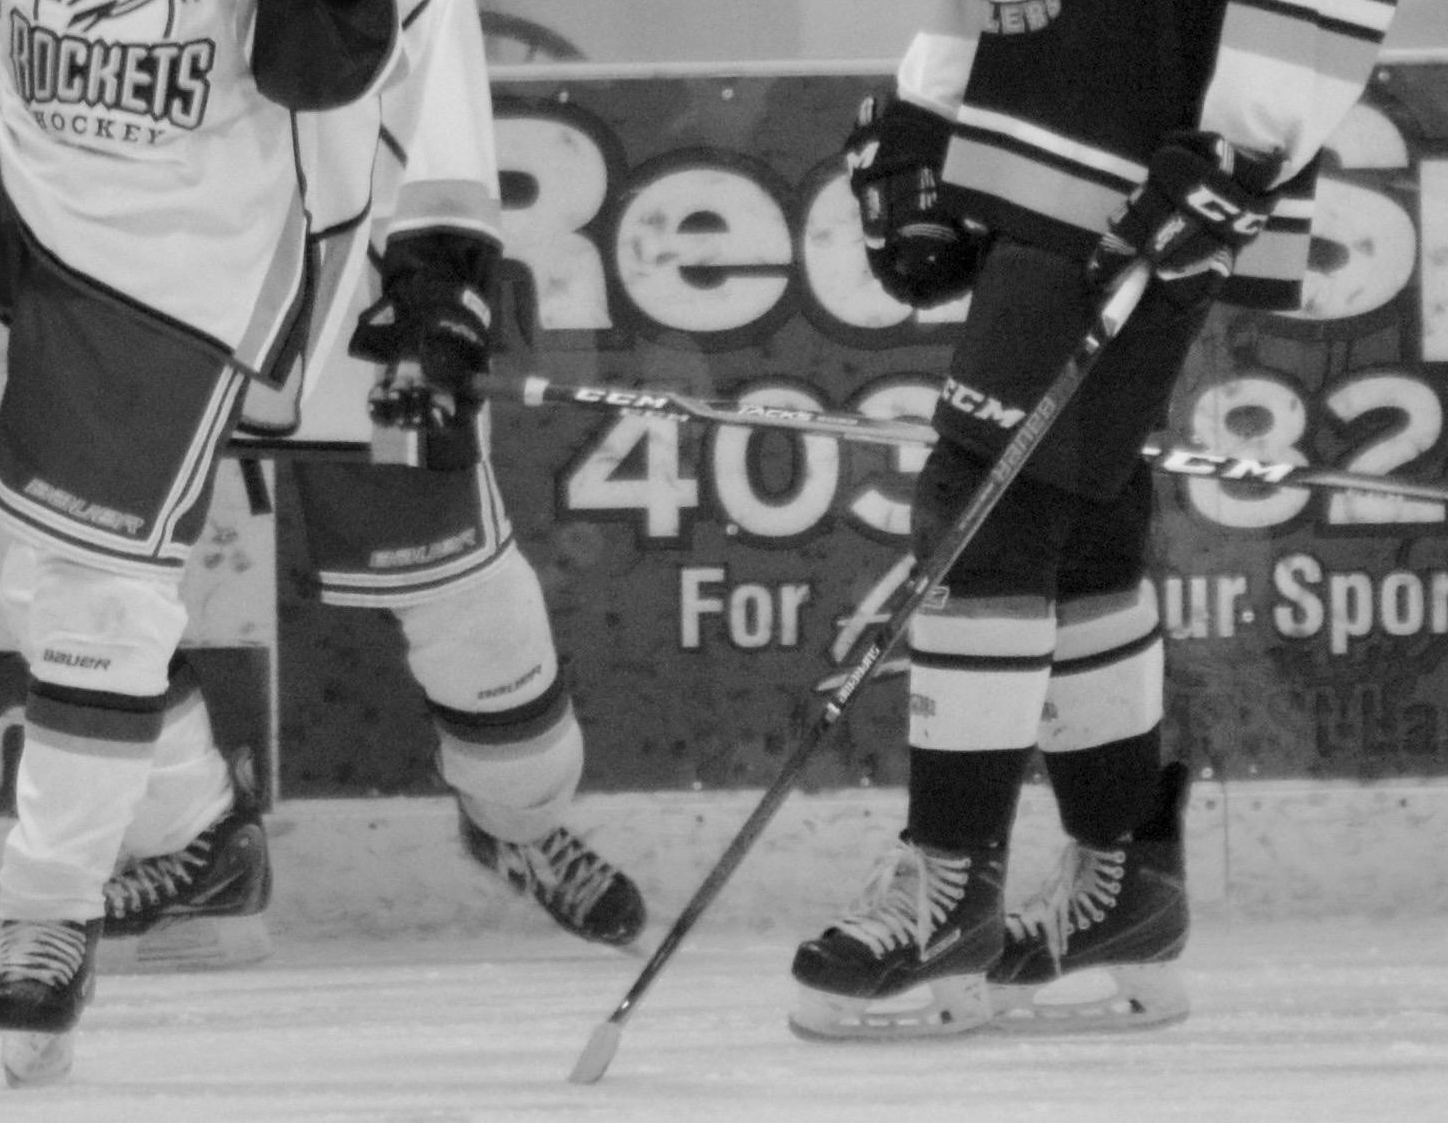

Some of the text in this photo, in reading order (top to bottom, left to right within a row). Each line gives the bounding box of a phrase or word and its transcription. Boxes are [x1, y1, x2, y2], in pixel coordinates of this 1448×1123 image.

[10, 7, 216, 131] ROCKETS
[32, 110, 166, 145] HOCKEY
[680, 566, 811, 649] For
